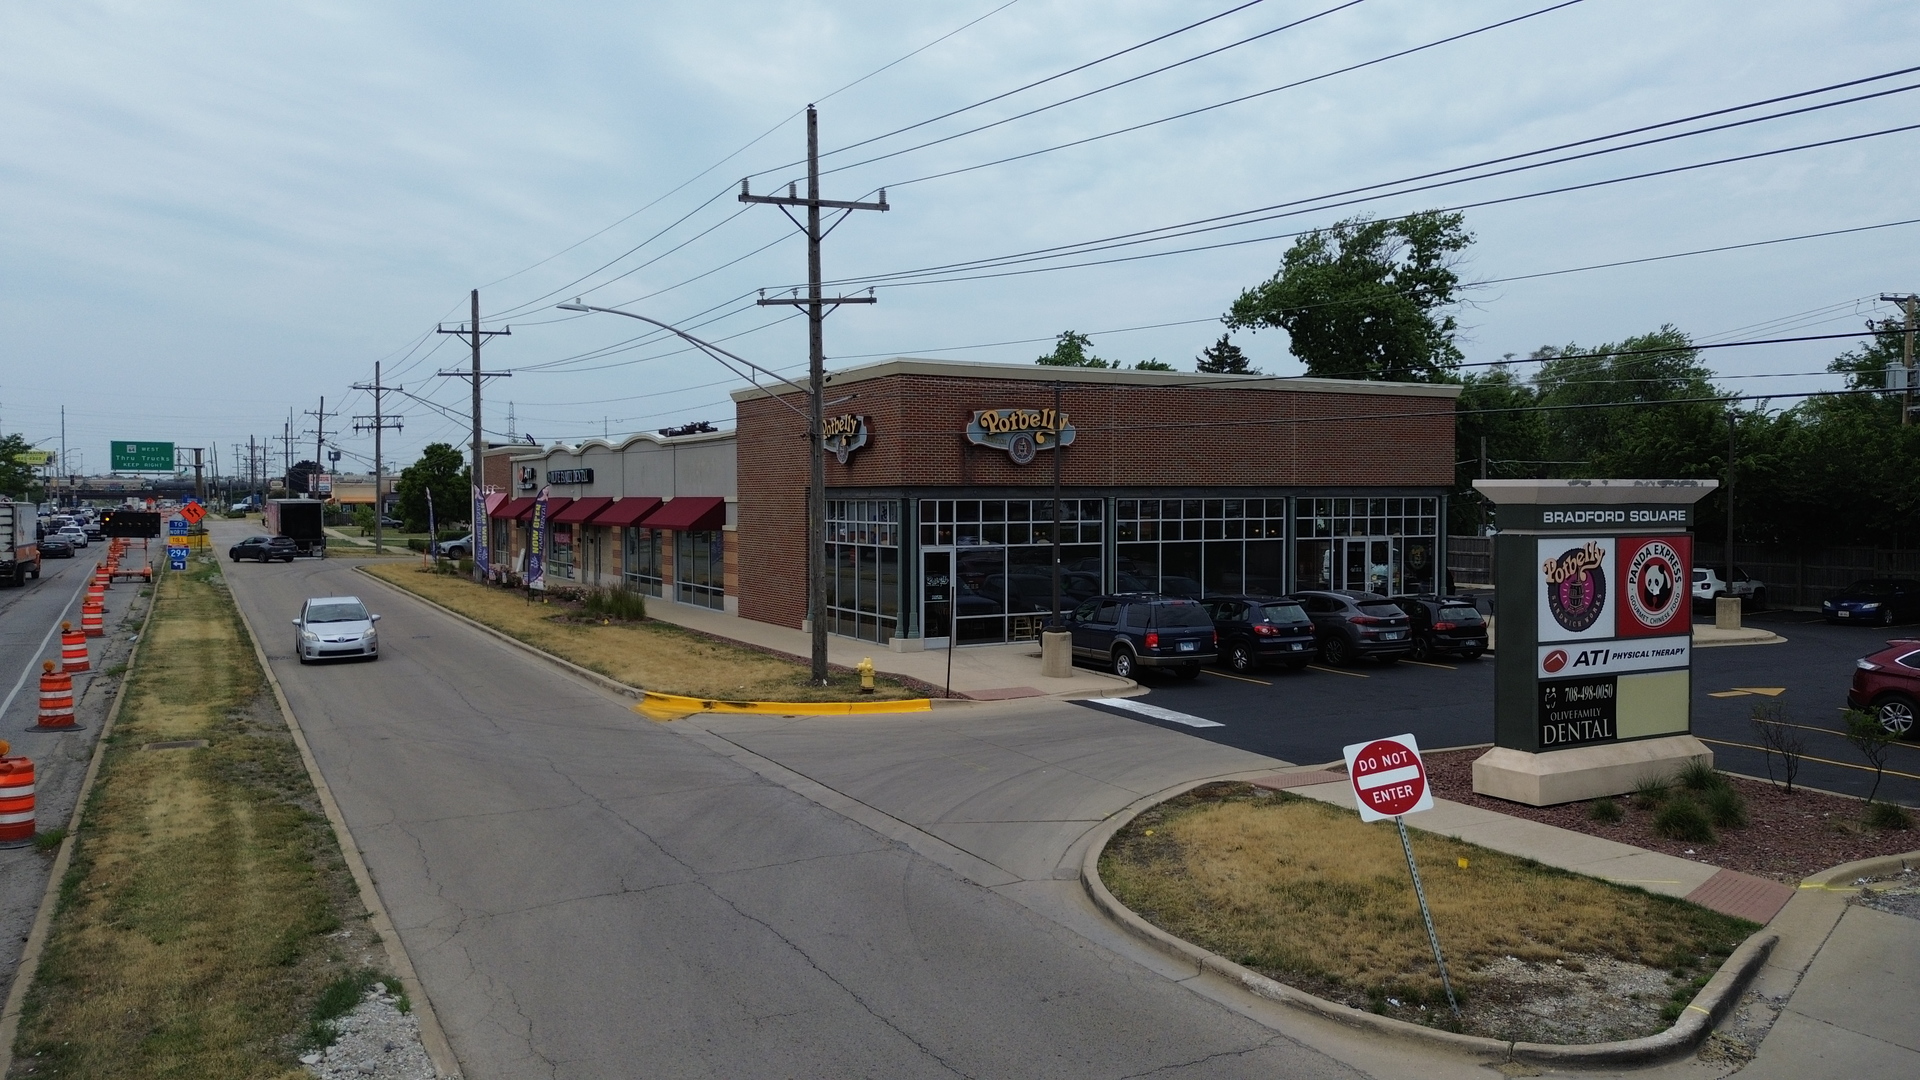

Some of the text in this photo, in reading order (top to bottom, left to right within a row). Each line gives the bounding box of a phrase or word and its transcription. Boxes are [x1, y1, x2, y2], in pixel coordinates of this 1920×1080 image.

[981, 408, 1069, 444] Potbelly
[533, 504, 542, 529] OPEN
[1543, 510, 1686, 523] BRADFORD SQUARE
[170, 549, 187, 557] 294
[1542, 541, 1605, 583] Potbelly
[1629, 544, 1682, 584] PANDA EXPRESS
[1551, 593, 1602, 627] SANDWICH WORKS
[1630, 592, 1680, 624] GOURMET CHINESE FOOD
[1573, 647, 1685, 667] ATI PHYSICAL THERAPY
[1565, 683, 1613, 702] 708-498-0050
[1550, 707, 1601, 721] OLIVE FAMILY
[1543, 718, 1612, 744] DENTAL
[1359, 750, 1407, 772] DO NOT
[1373, 784, 1414, 804] ENTER
